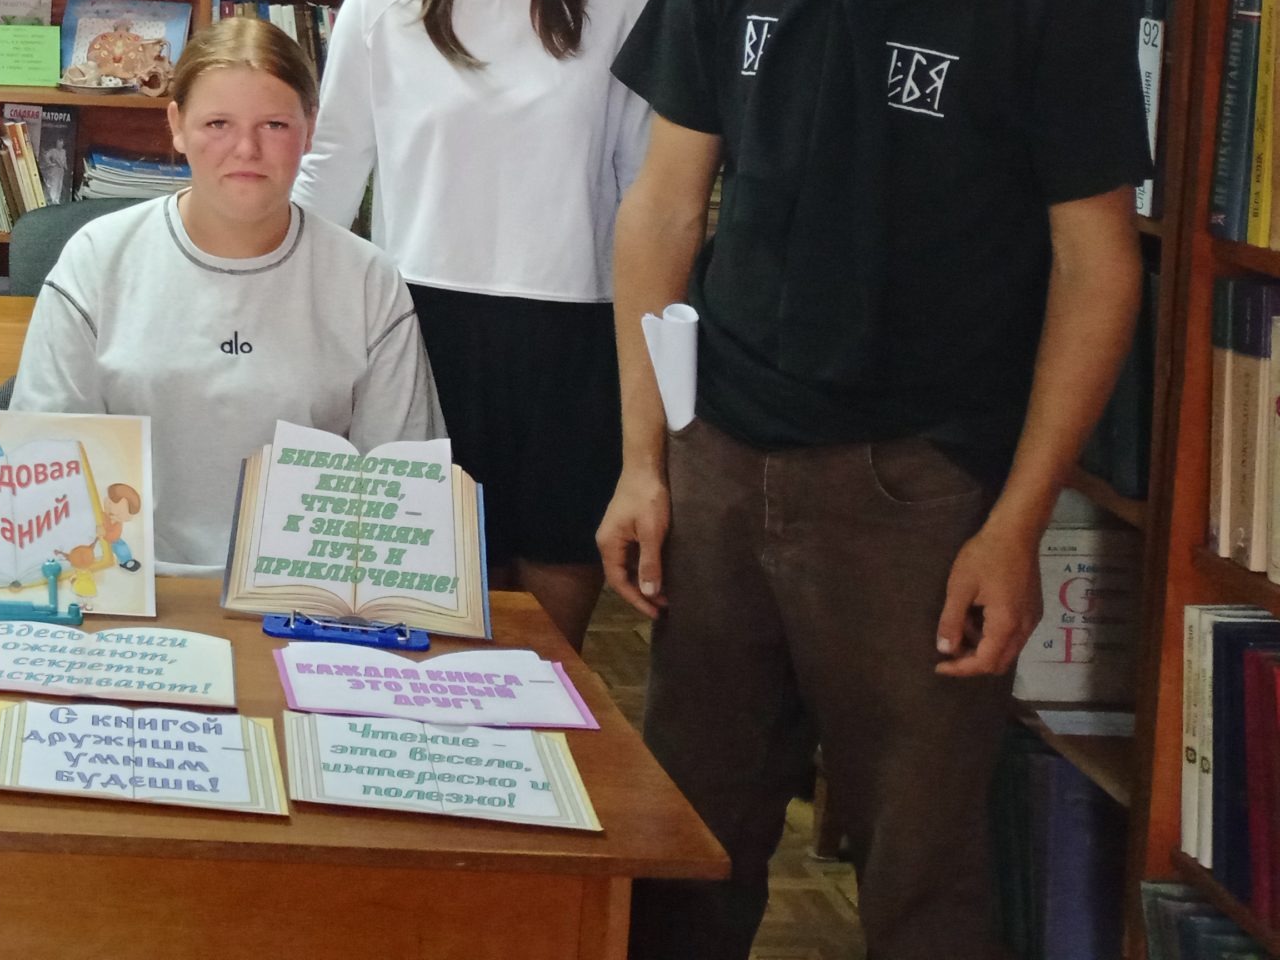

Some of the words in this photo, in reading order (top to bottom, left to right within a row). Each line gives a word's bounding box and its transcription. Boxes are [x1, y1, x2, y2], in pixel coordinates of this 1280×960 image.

[42, 111, 71, 122] КАТОРГА
[220, 331, 253, 355] alo
[282, 514, 304, 533] К
[307, 539, 377, 563] ПУТЬ
[384, 547, 407, 566] И
[95, 630, 189, 649] книги
[1, 640, 179, 665] оживают,
[13, 656, 165, 677] секреты
[296, 662, 420, 681] КАЖДАЯ
[425, 669, 523, 687] КНИГА
[347, 678, 403, 692] ЭТО
[409, 681, 516, 700] НОВЫЙ
[393, 693, 484, 710] ДРУГ!
[49, 706, 78, 725] С
[348, 722, 480, 748] Чтение
[330, 744, 398, 759] это
[321, 762, 517, 790] интересно
[530, 780, 552, 792] и
[362, 784, 517, 809] полезно!
